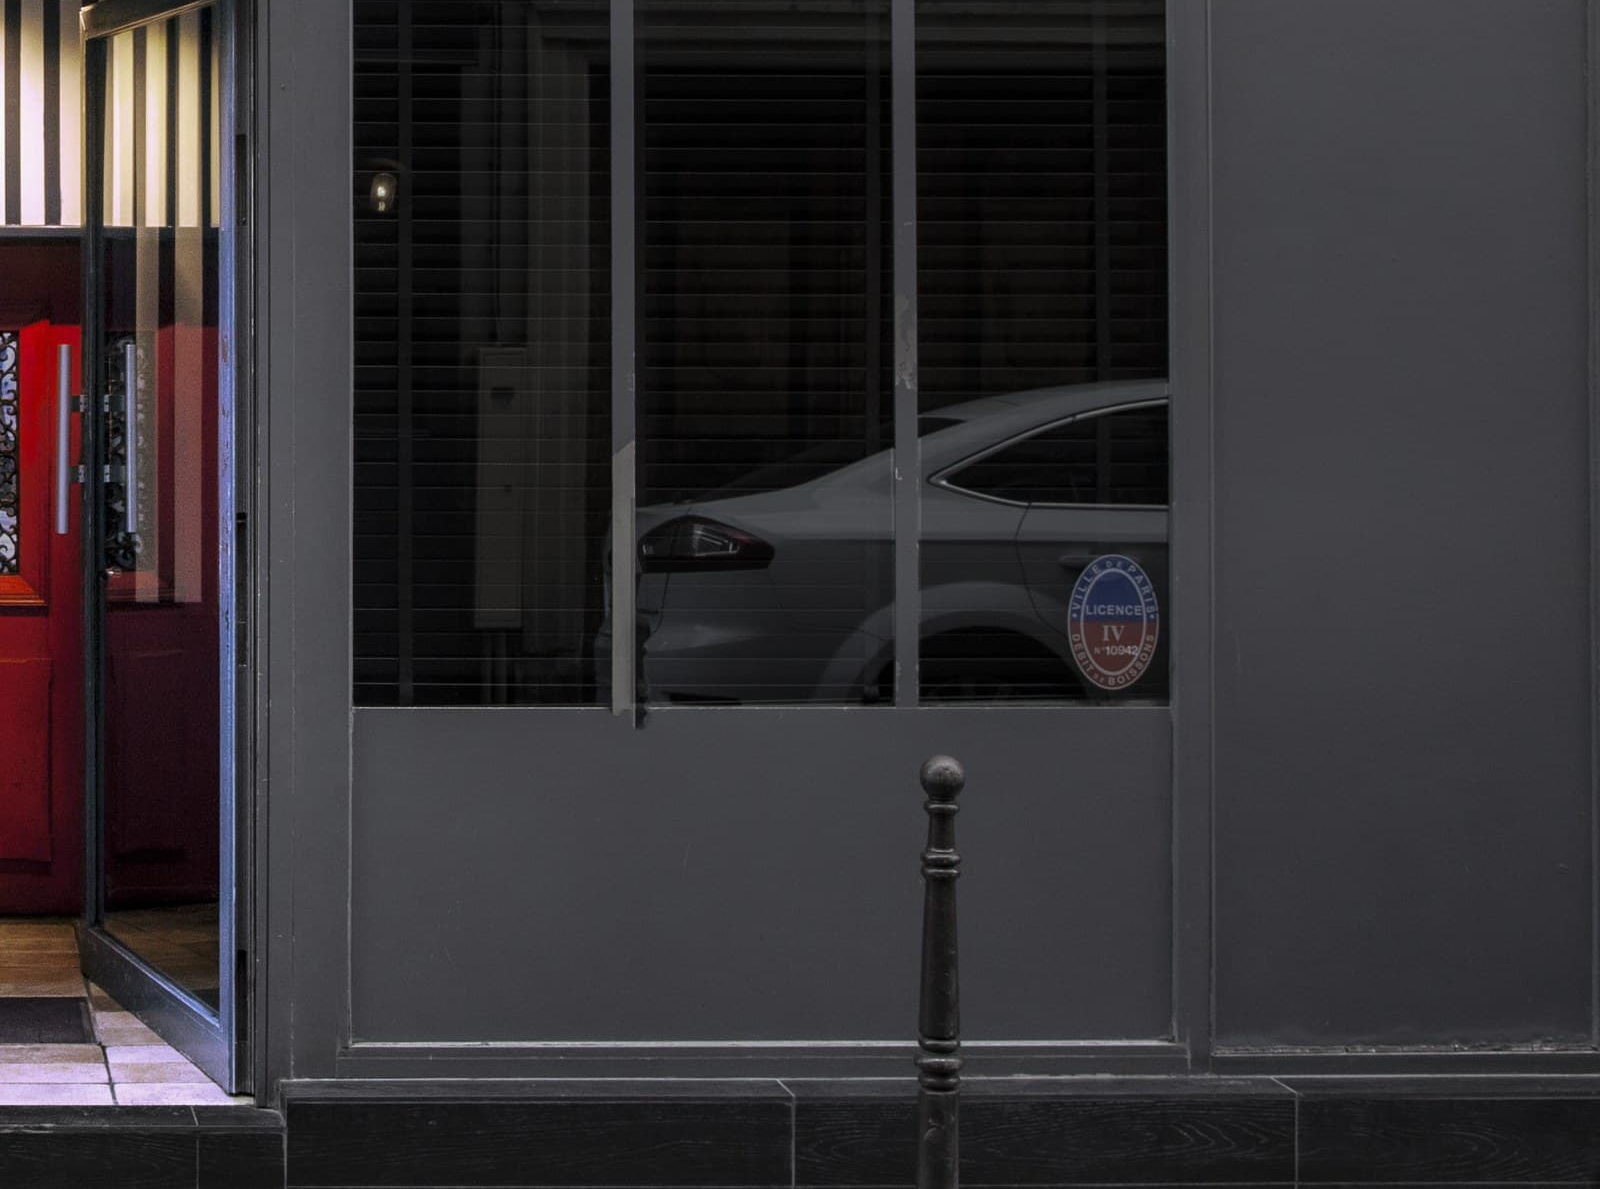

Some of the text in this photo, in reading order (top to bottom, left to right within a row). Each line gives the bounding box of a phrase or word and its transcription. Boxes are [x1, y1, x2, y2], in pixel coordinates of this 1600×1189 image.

[1071, 564, 1102, 610] VILLE
[1127, 564, 1156, 613] PARIS
[1085, 604, 1143, 616] LICENCE
[1102, 625, 1125, 641] IV
[1107, 634, 1156, 686] BOISSONS
